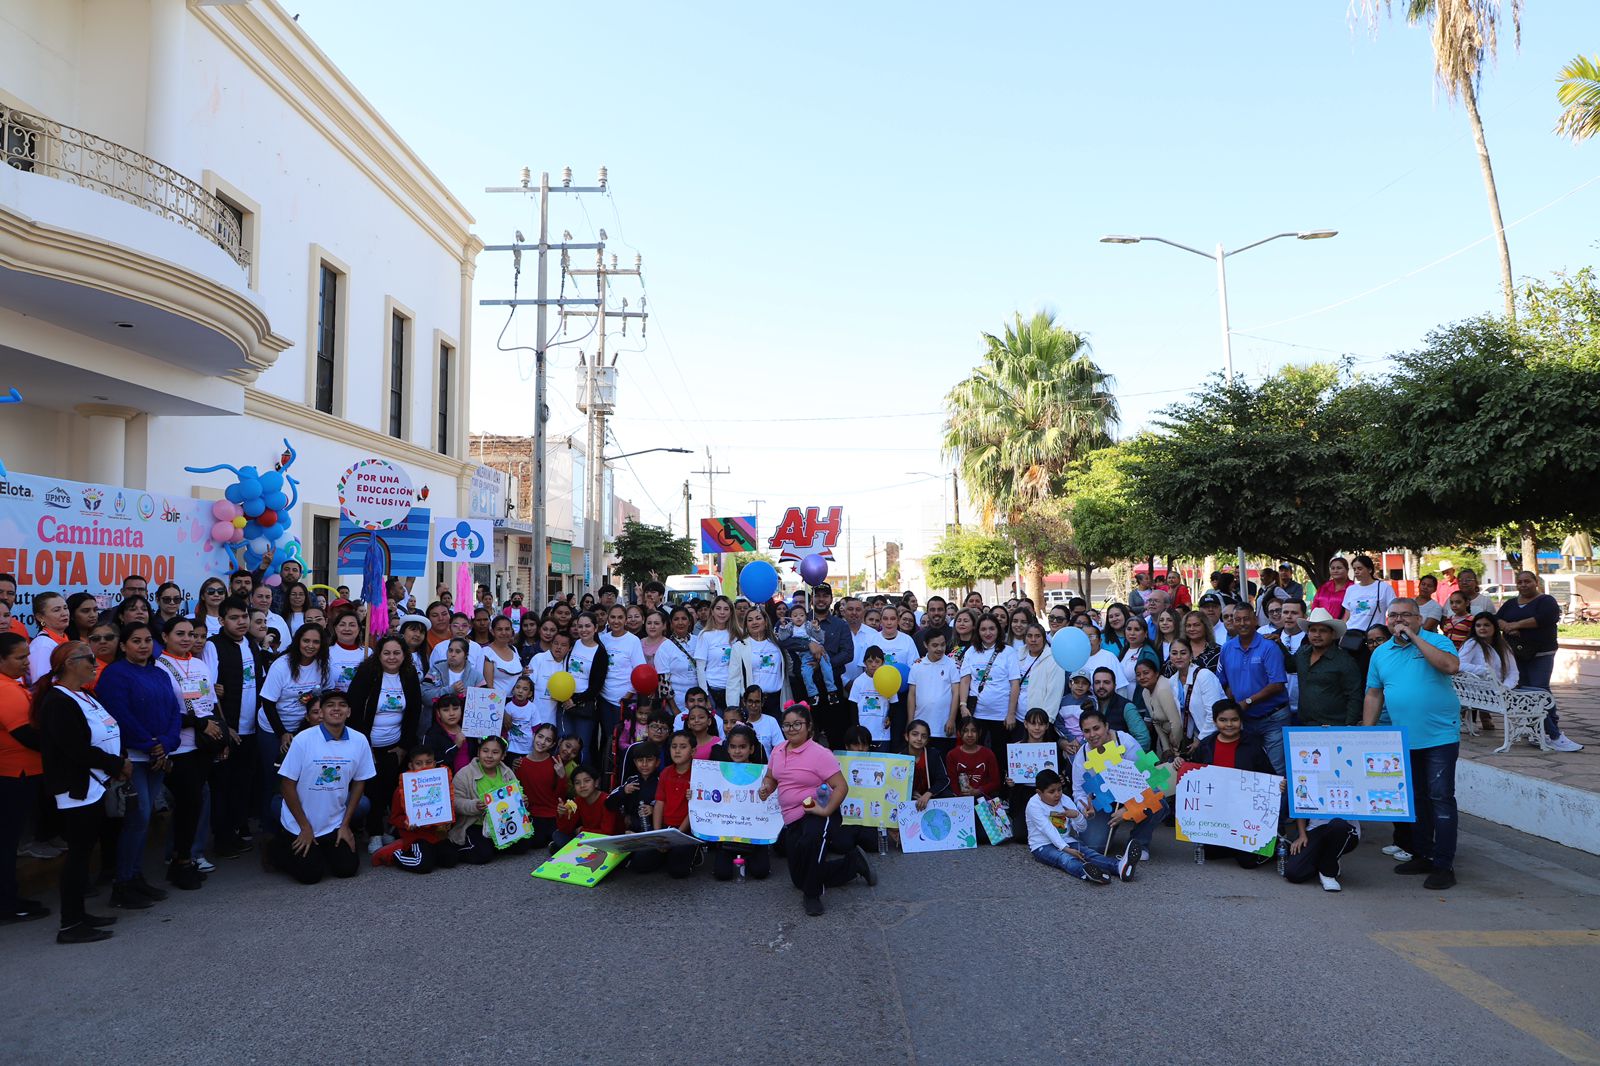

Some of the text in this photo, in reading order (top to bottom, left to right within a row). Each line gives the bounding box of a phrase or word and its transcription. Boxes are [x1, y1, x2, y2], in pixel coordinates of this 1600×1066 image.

[357, 473, 400, 484] POR UNA
[356, 484, 413, 496] EDUCACIÓN
[356, 495, 411, 507] INCLUSIVA
[37, 515, 144, 548] Caminata
[767, 505, 844, 549] AH
[0, 547, 175, 586] ELOTA UNIDO!
[411, 778, 418, 793] 3
[1186, 779, 1201, 794] NI
[1184, 797, 1200, 811] NI
[1198, 820, 1231, 830] personas
[1243, 819, 1261, 832] Que
[1183, 829, 1218, 839] especiales
